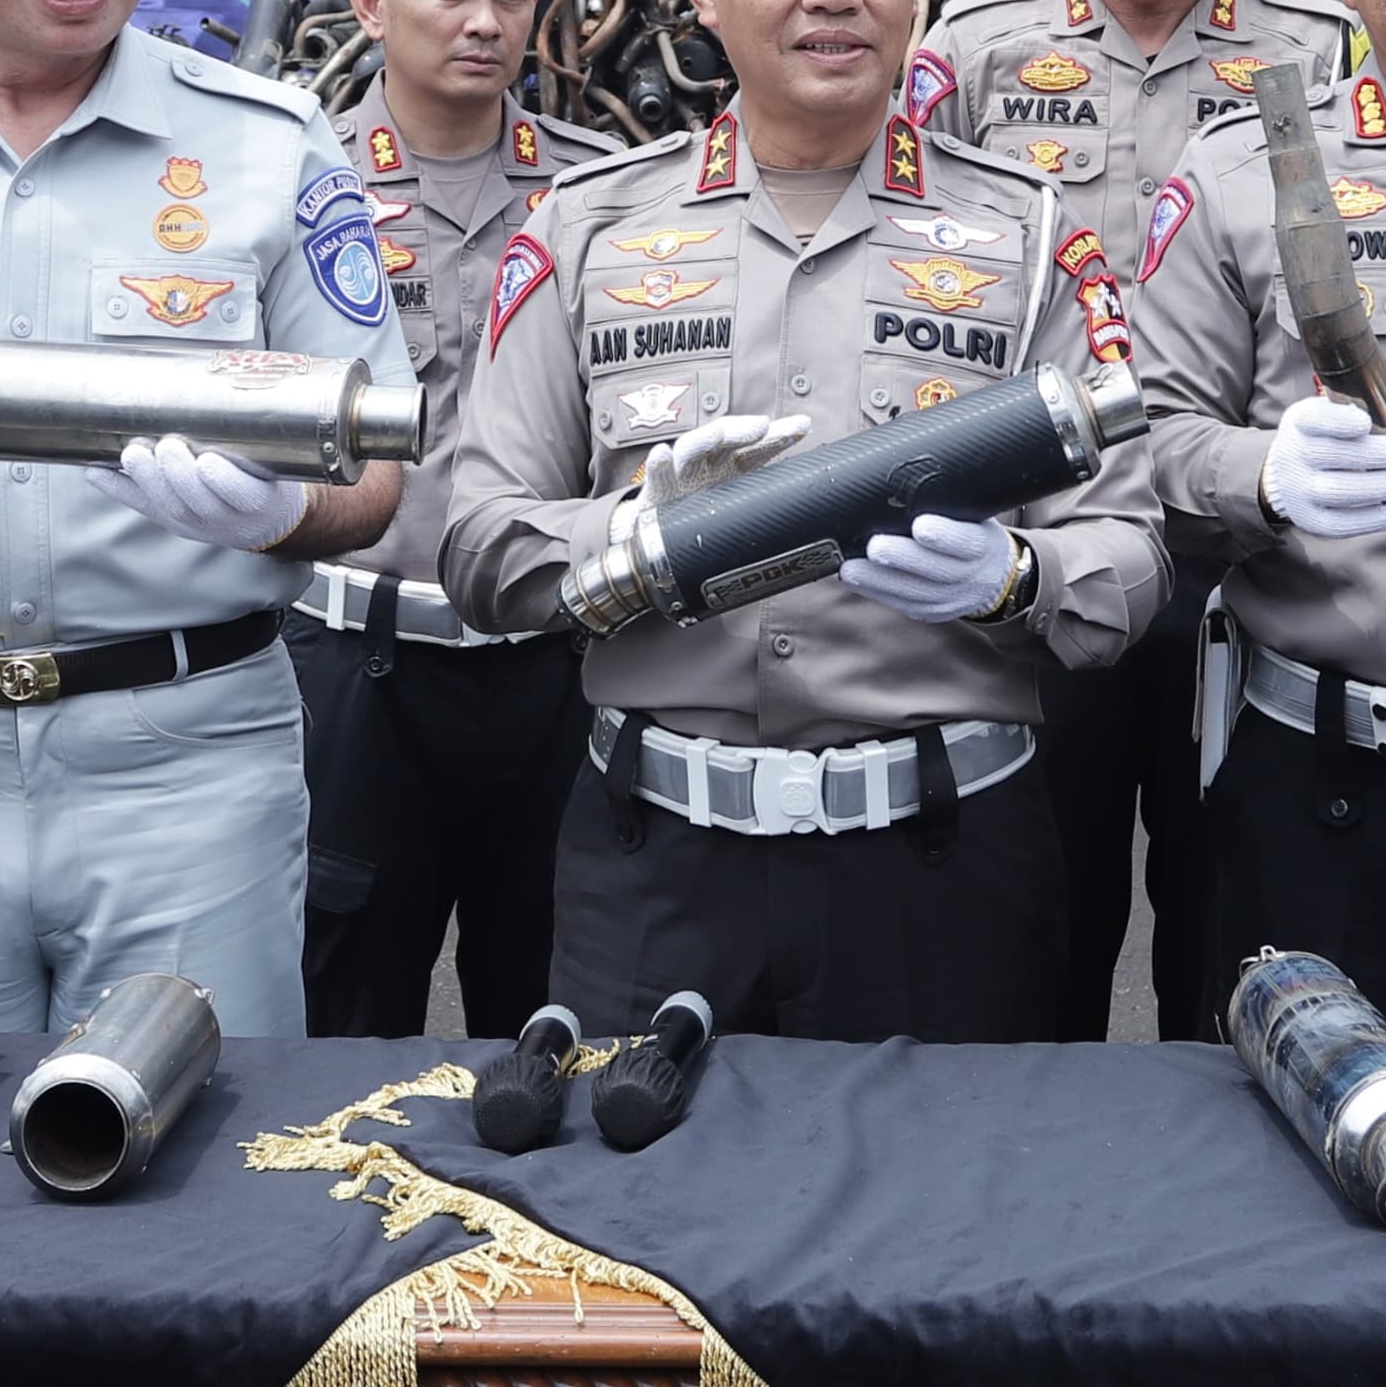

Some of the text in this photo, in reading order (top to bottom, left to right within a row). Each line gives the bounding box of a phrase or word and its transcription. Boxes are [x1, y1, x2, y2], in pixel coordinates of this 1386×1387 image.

[1003, 97, 1098, 124] WIRA
[298, 177, 336, 216] KANTOR
[317, 240, 344, 261] JASA
[590, 317, 731, 368] AAN SUHANAN
[874, 312, 1007, 369] POLRI
